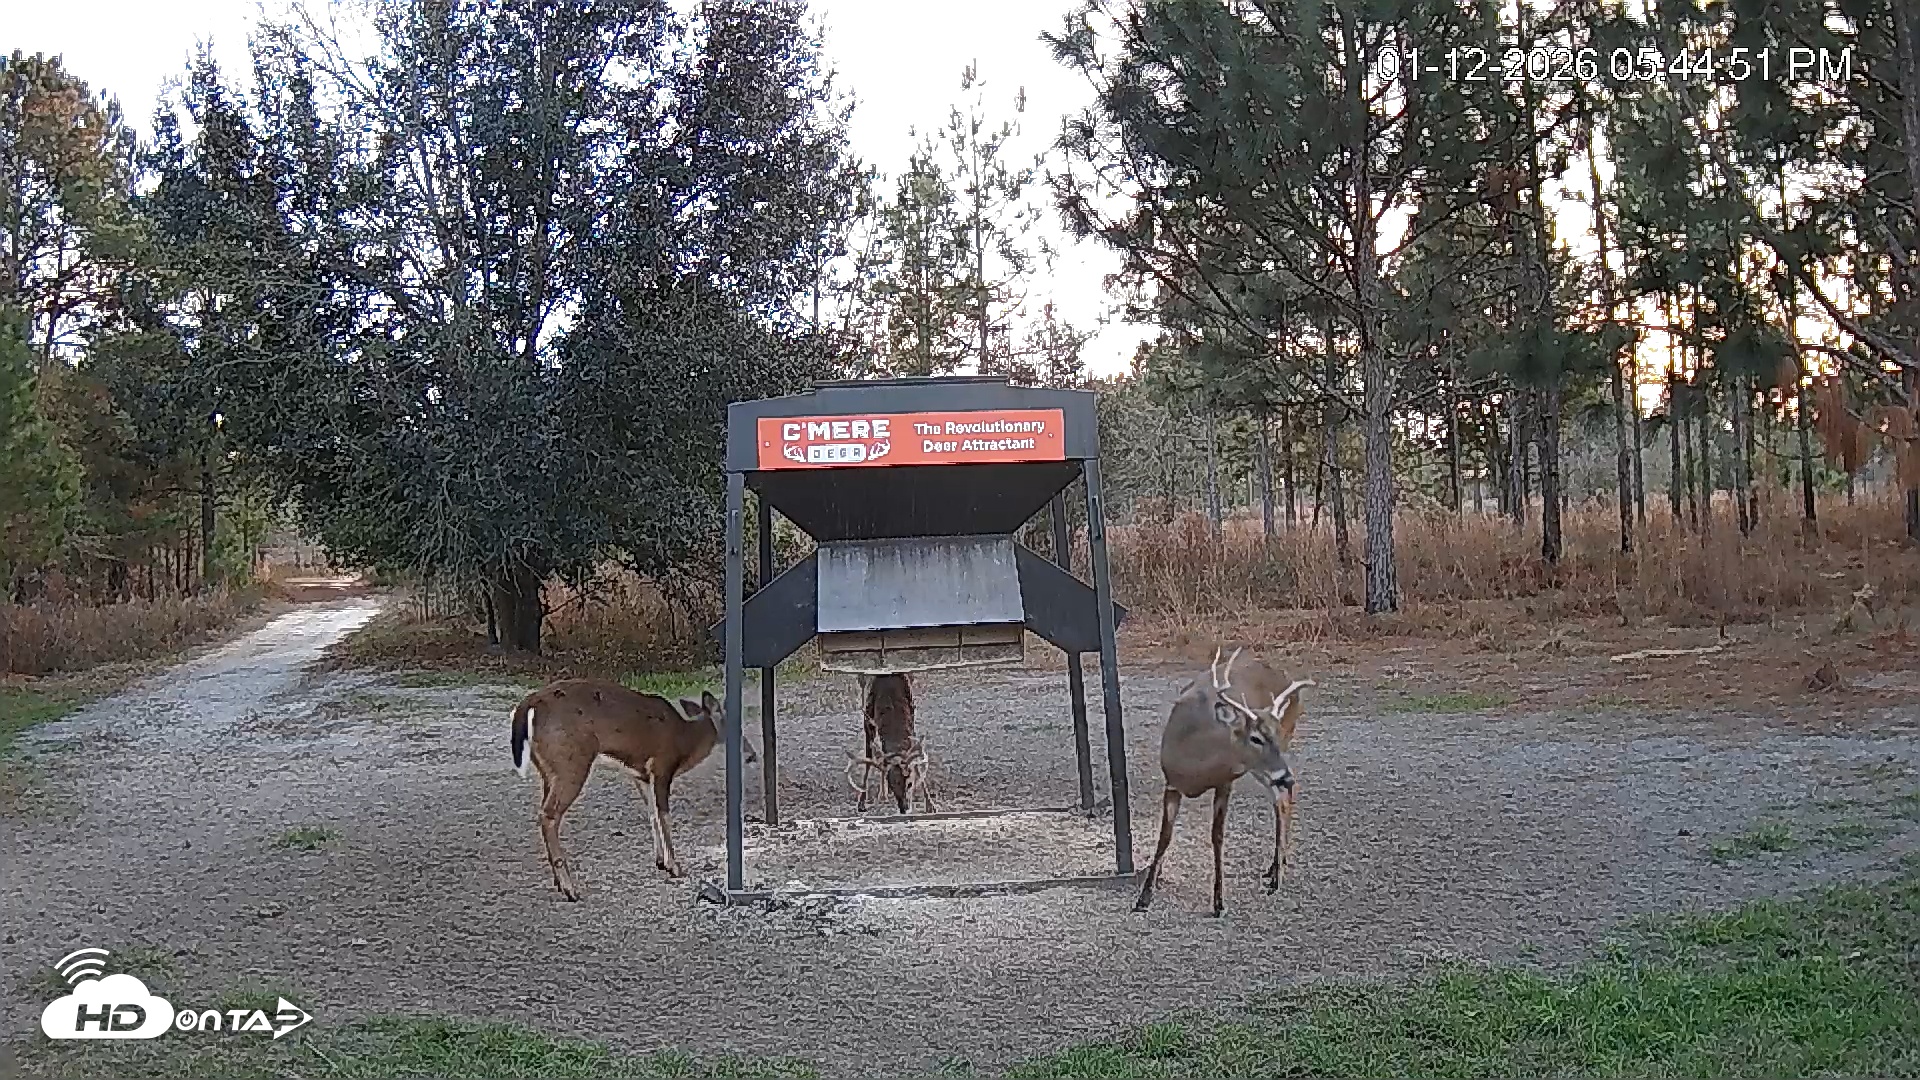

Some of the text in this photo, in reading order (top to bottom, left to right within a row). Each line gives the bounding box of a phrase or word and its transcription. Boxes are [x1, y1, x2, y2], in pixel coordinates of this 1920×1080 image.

[783, 419, 891, 441] C'MERE
[914, 420, 1045, 435] The Revolutionary
[923, 438, 1035, 453] Deer Attractant
